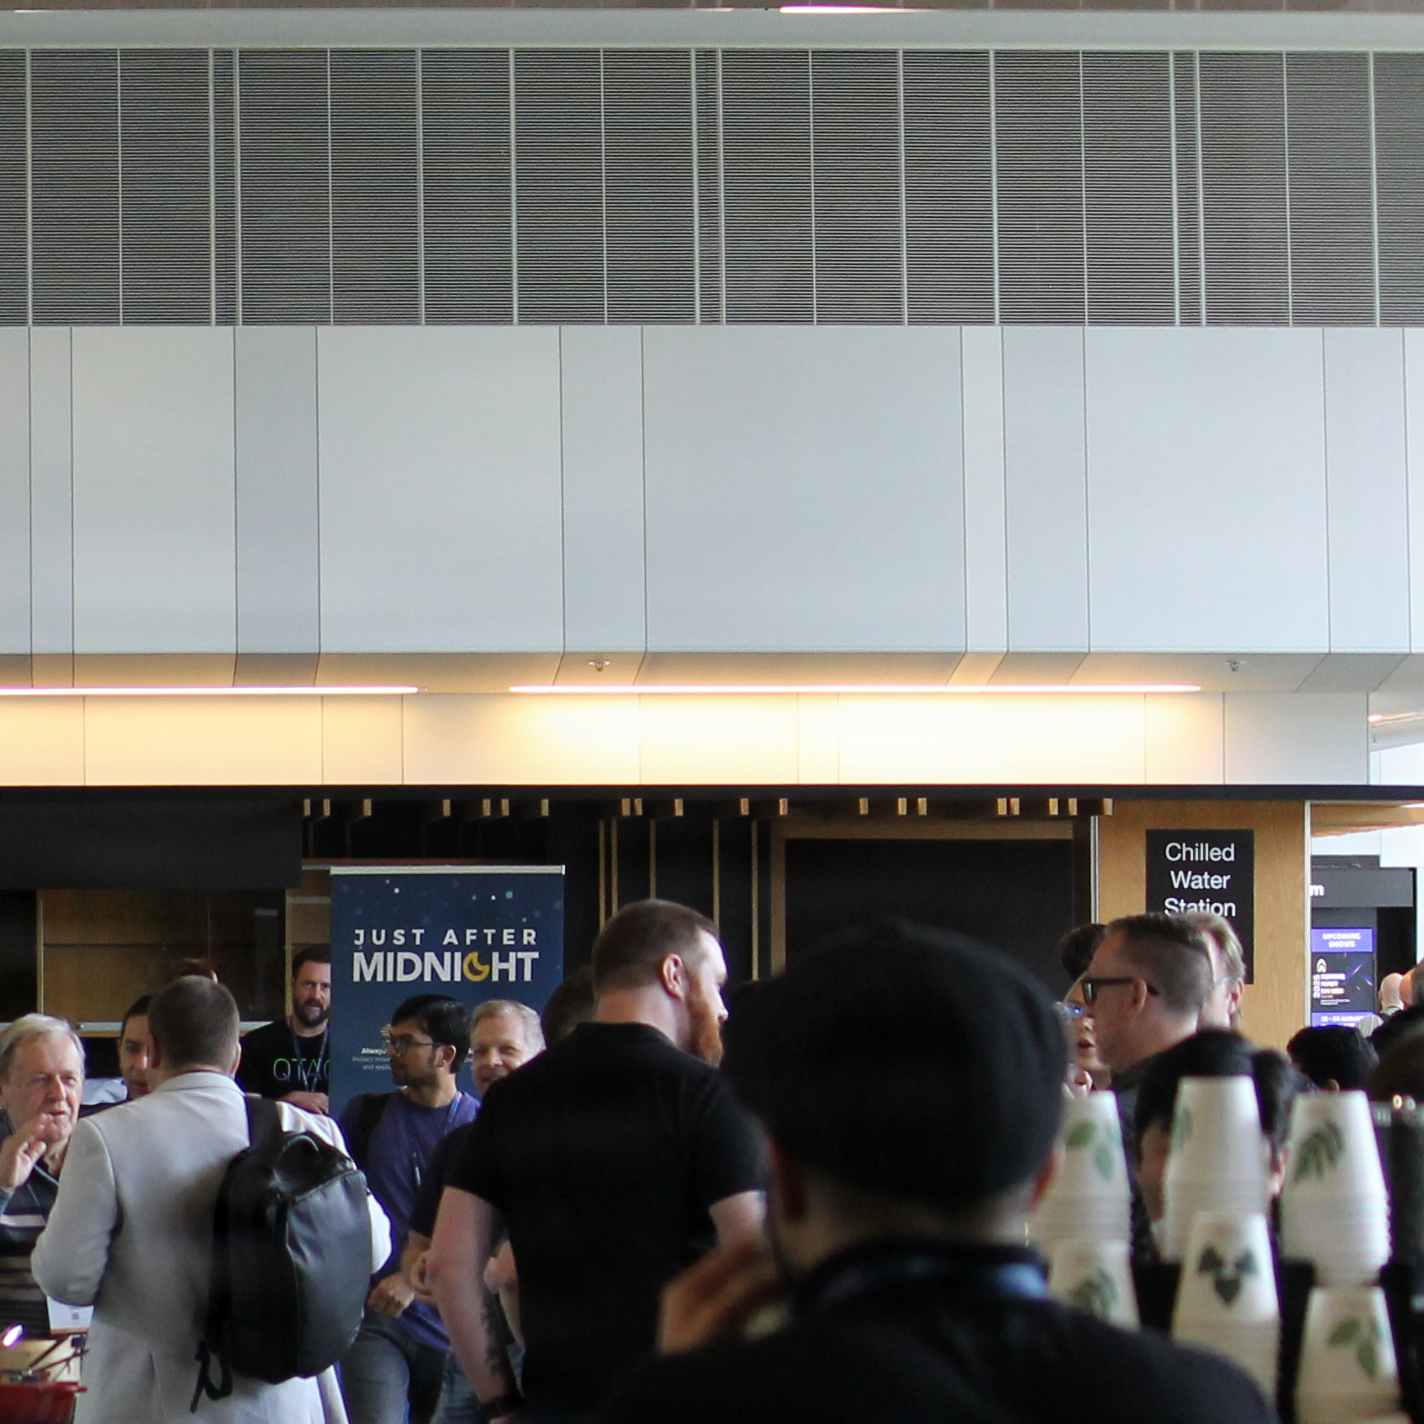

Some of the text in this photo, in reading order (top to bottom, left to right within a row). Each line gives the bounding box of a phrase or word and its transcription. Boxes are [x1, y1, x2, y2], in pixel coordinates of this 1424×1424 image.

[1165, 842, 1235, 862] Chilled
[1170, 870, 1231, 889] Water
[1164, 897, 1237, 917] Station
[353, 929, 537, 946] JUST AFTER
[352, 951, 540, 983] MIDNIGHT
